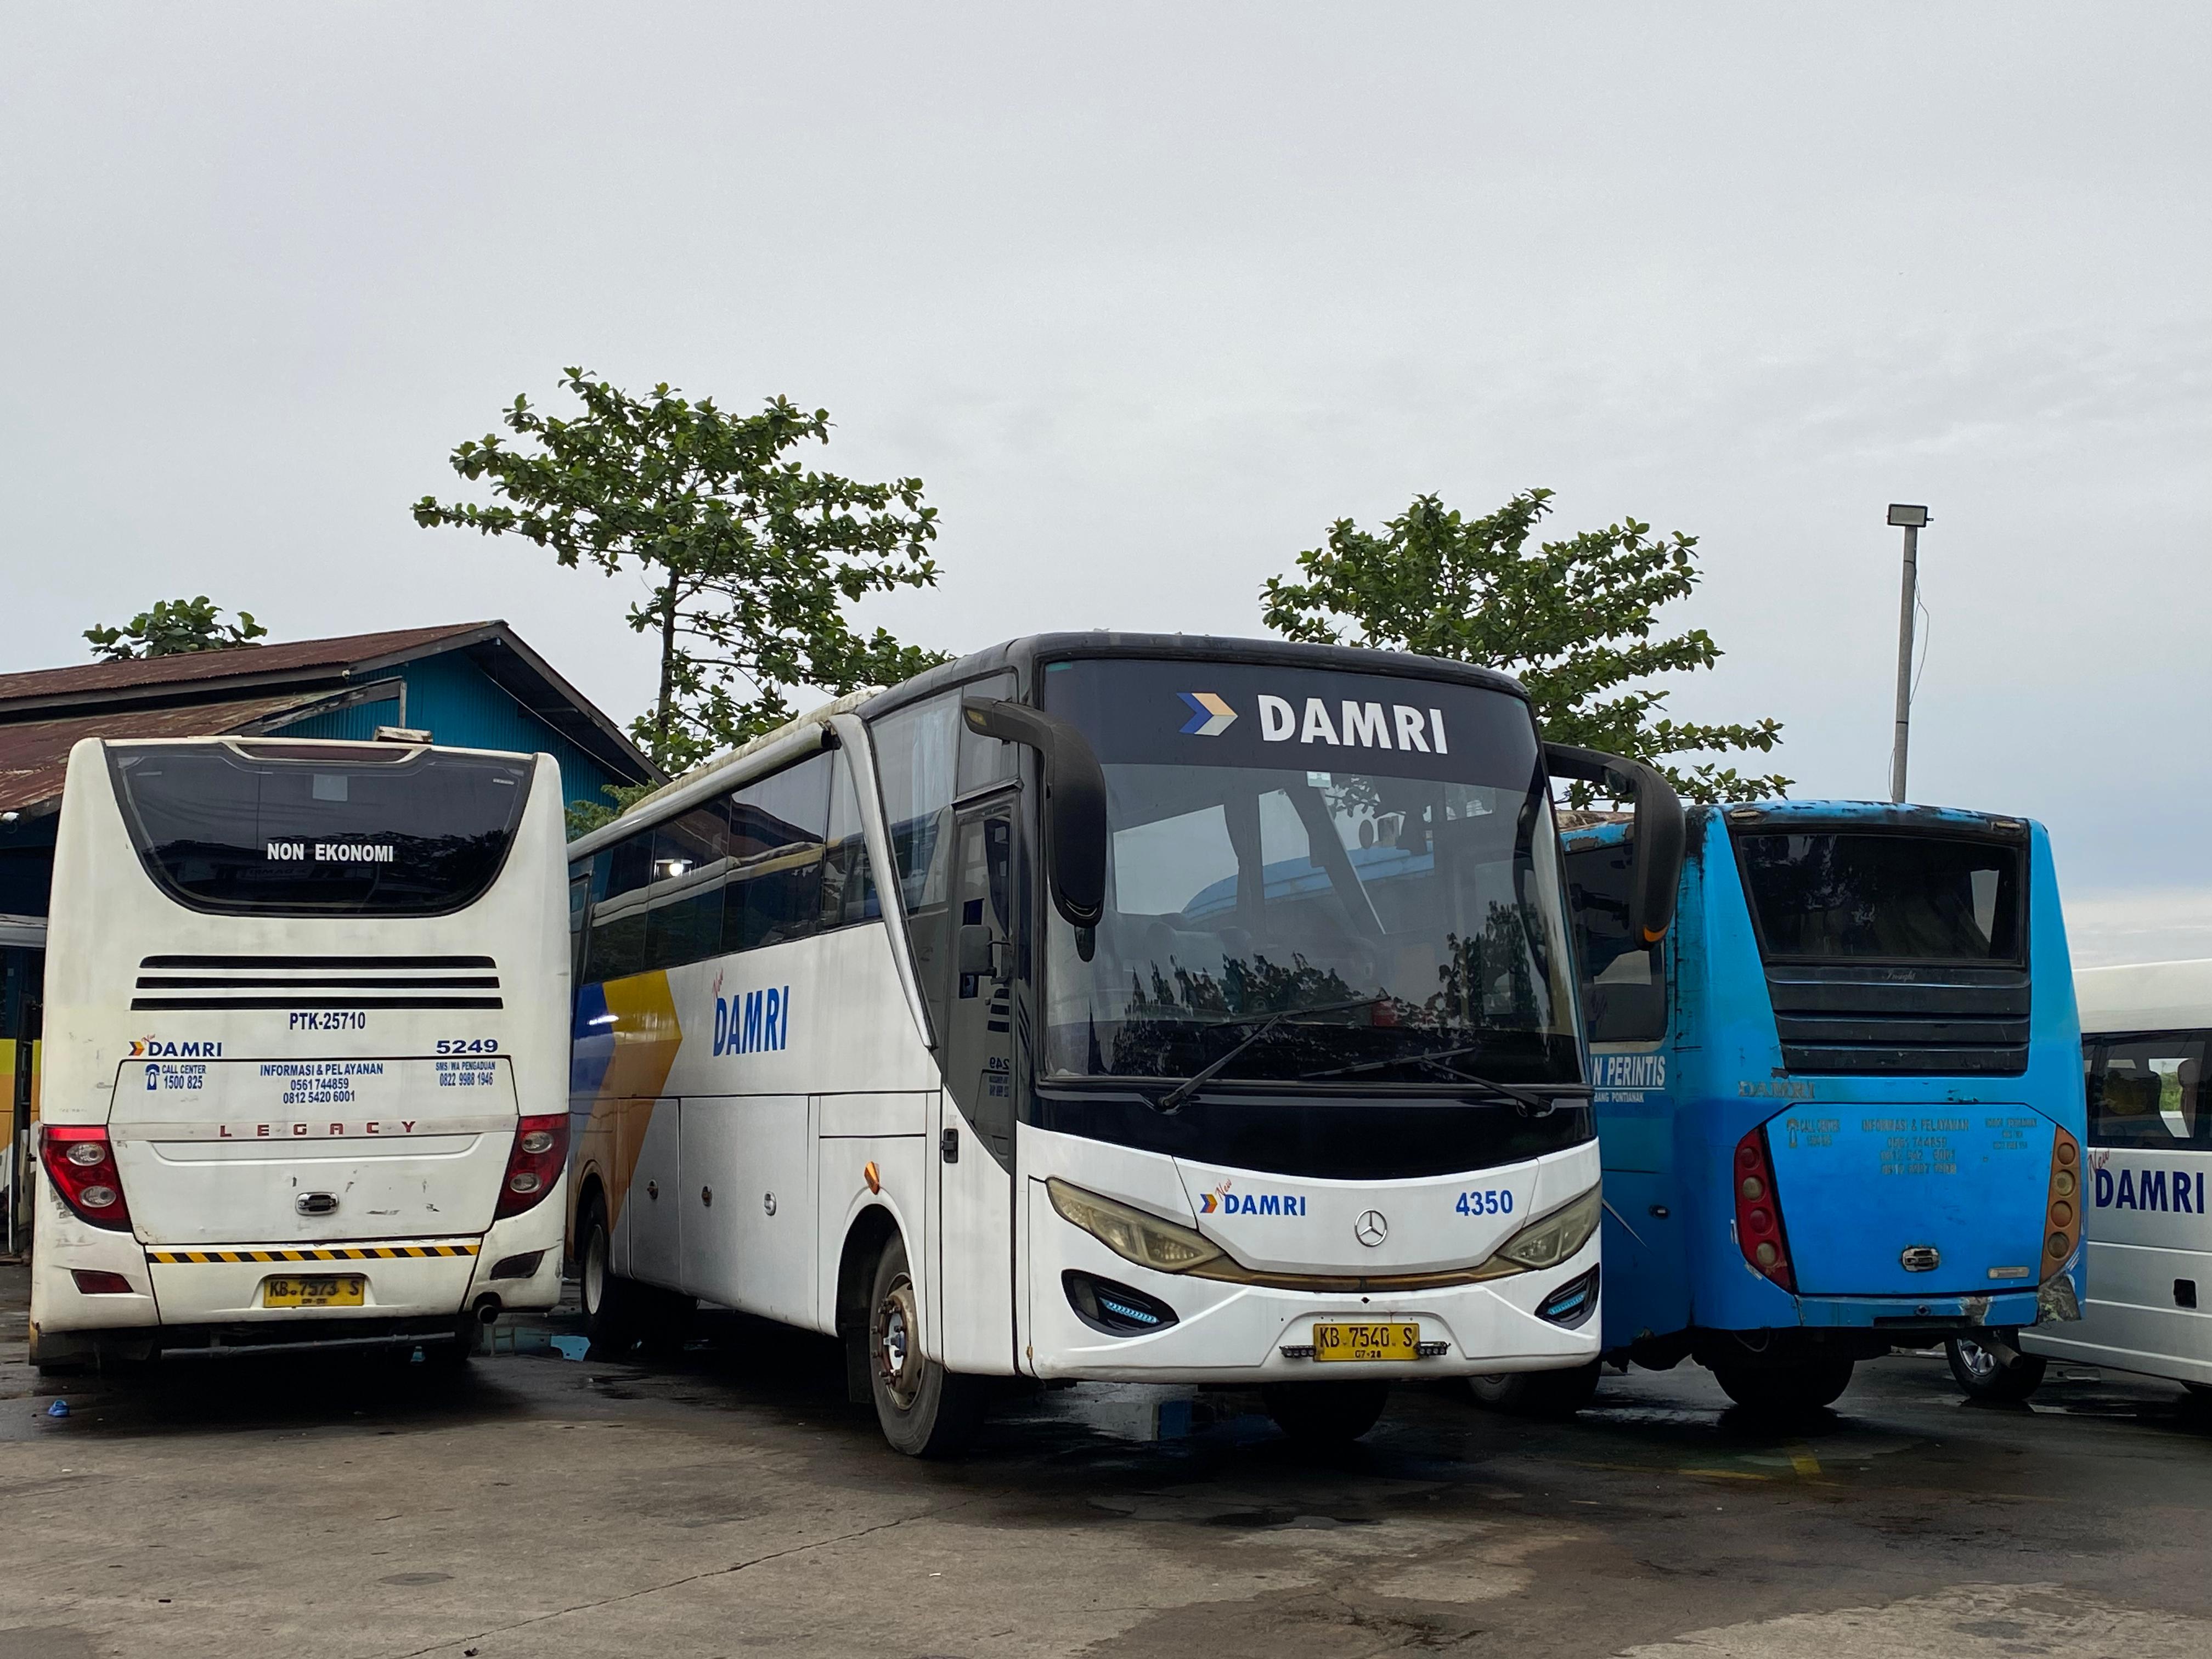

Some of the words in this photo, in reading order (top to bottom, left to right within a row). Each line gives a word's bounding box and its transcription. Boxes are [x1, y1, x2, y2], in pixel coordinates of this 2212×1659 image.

[1257, 695, 1448, 754] DAMRI
[267, 843, 304, 860] NON
[315, 844, 393, 862] EKONOMI
[290, 1012, 366, 1030] PTK-25710
[713, 985, 789, 1057] DAMRI
[148, 1042, 222, 1057] DAMRI
[436, 1039, 498, 1054] 5249
[162, 1065, 178, 1074] CALL
[180, 1065, 206, 1074] CENTER
[260, 1064, 314, 1076] INFORMASI
[317, 1064, 323, 1075] &
[462, 1062, 495, 1070] PENGADUAN
[1591, 1057, 1602, 1086] N
[1607, 1056, 1666, 1086] PERINTIS
[165, 1075, 184, 1089] 1500
[187, 1075, 202, 1089] 825
[291, 1079, 312, 1091] 0561
[315, 1077, 349, 1090] 744859
[440, 1073, 455, 1086] 0822
[283, 1092, 306, 1104] 0812
[308, 1091, 330, 1103] 5420
[334, 1090, 355, 1102] 6001
[1612, 1092, 1644, 1103] PONTIANAK
[1738, 1080, 1815, 1098] DAMRI
[219, 1121, 416, 1137] LEGACY
[2088, 1148, 2110, 1181] New
[1215, 1179, 1232, 1201] New
[2096, 1169, 2204, 1214] DAMRI
[1224, 1194, 1306, 1216] DAMRI
[1455, 1189, 1513, 1216] 4350
[270, 1281, 288, 1296] KB
[349, 1280, 359, 1295] S
[1320, 1327, 1340, 1347] KB
[1349, 1327, 1389, 1347] 7540
[1403, 1327, 1412, 1347] S
